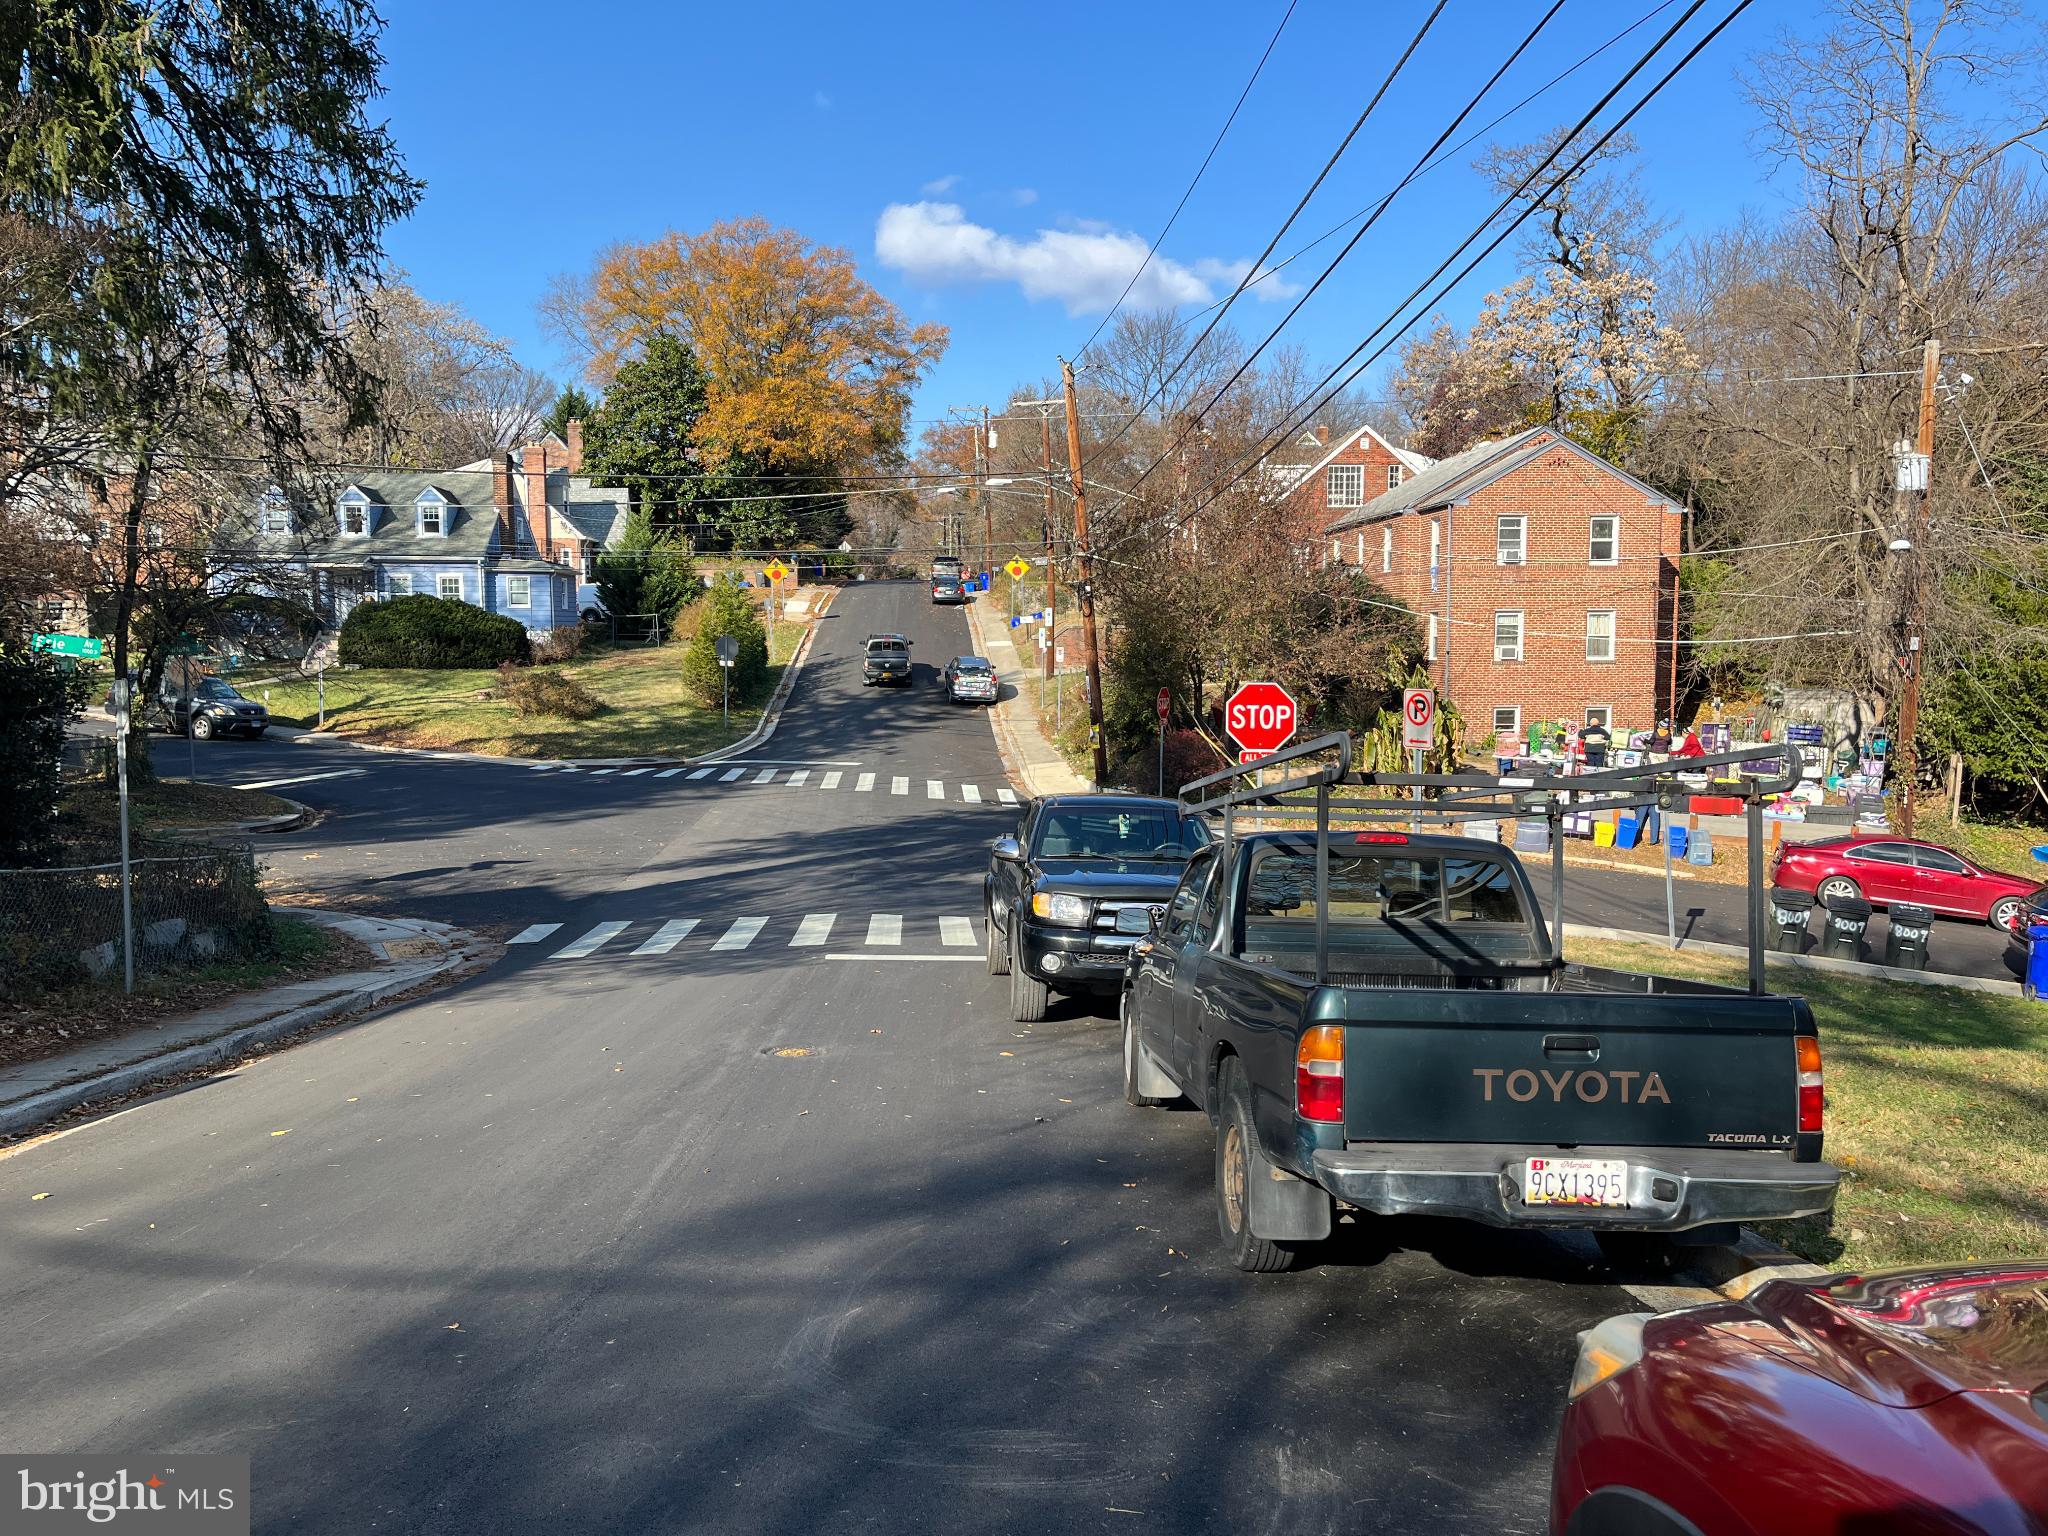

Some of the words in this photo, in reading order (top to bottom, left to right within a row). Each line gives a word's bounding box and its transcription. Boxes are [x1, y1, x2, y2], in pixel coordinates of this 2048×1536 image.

[1231, 704, 1291, 730] STOP
[1472, 1068, 1672, 1104] TOYOTA
[1707, 1133, 1767, 1143] TACOMA
[1772, 1134, 1791, 1144] LX
[1532, 1171, 1621, 1199] 9CX1395
